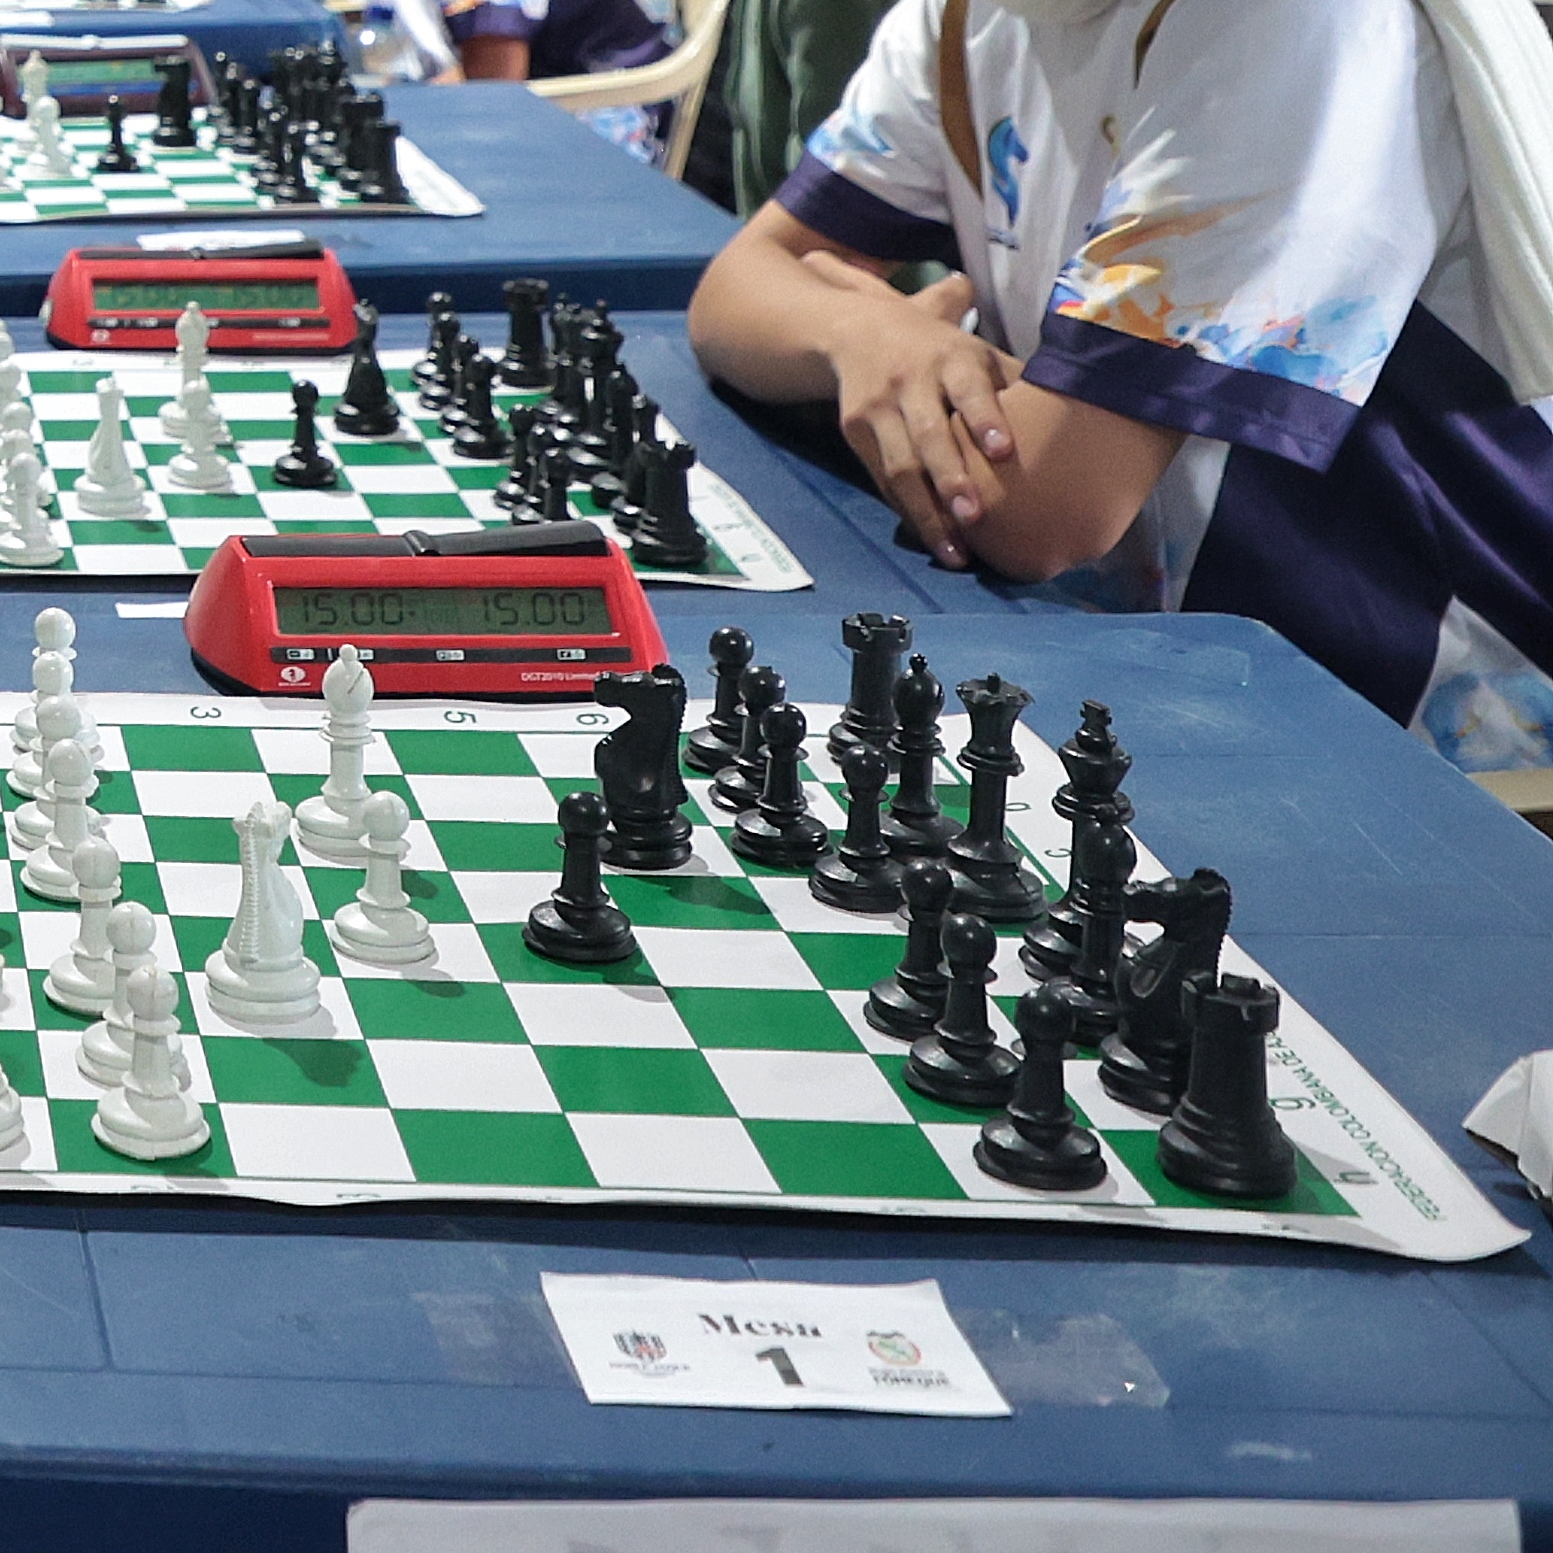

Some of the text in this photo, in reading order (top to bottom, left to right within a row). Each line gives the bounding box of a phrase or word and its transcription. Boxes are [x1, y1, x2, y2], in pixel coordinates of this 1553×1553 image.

[189, 705, 223, 720] 3
[443, 709, 477, 725] 5
[575, 712, 610, 727] 6
[698, 1313, 822, 1338] Mesa
[755, 1346, 805, 1386] 1
